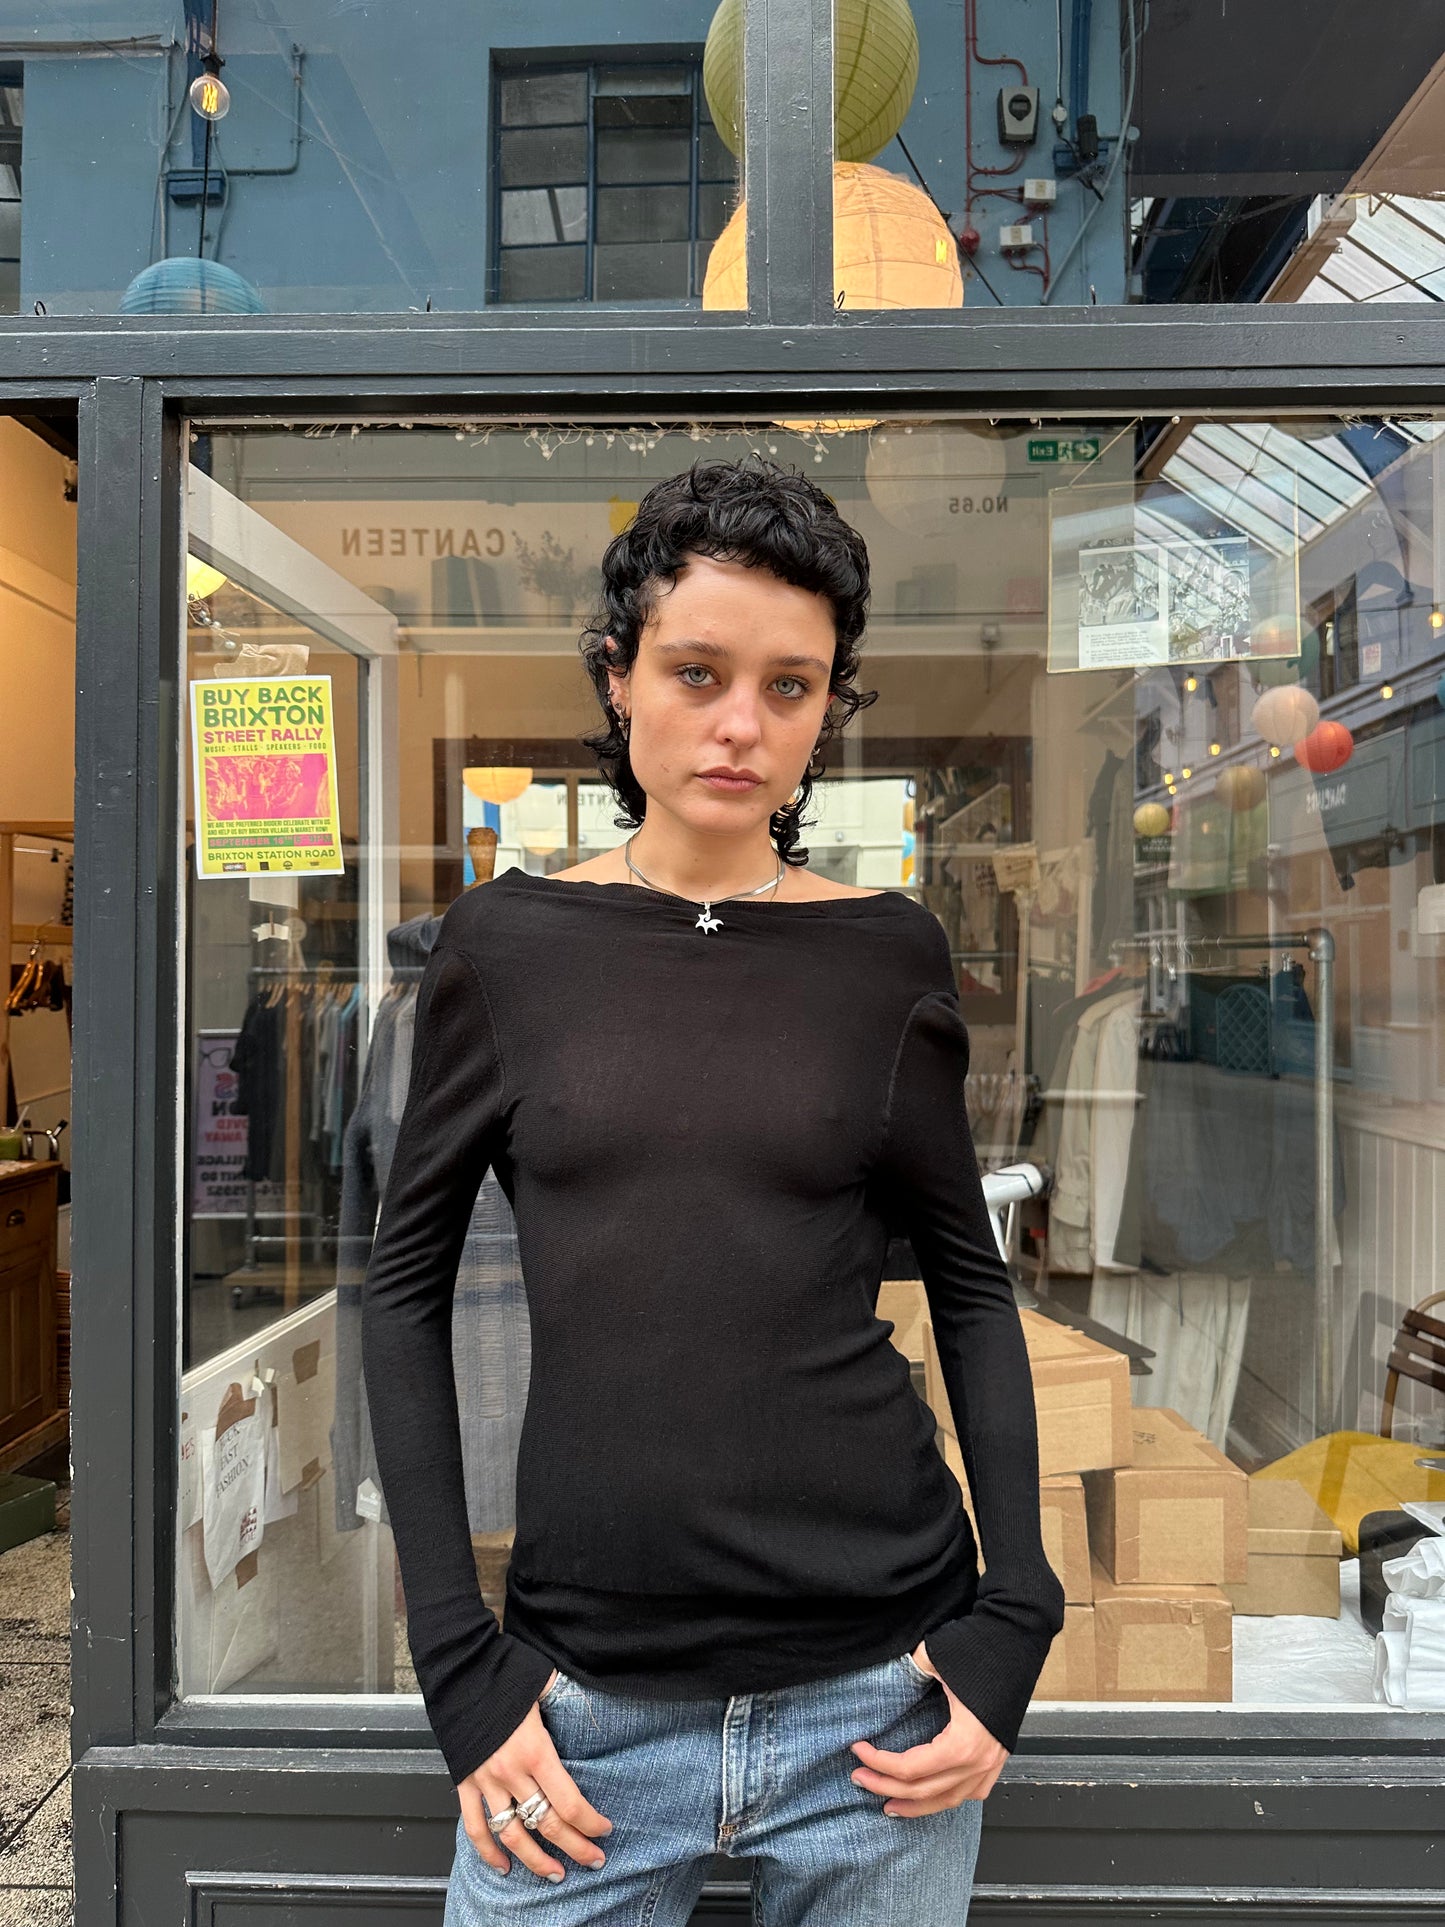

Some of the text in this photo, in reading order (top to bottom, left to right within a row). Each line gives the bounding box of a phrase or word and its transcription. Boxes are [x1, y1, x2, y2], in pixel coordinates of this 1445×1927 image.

[203, 686, 323, 706] BUY BACK
[204, 705, 325, 728] BRIXTON
[203, 727, 323, 744] STREET RALLY
[205, 742, 327, 753] MUSIC STALLS SPEAKERS FOOD
[209, 837, 270, 847] SEPTEMBER
[208, 849, 336, 861] BRIXTON STATION ROAD
[215, 1454, 250, 1499] FASHION
